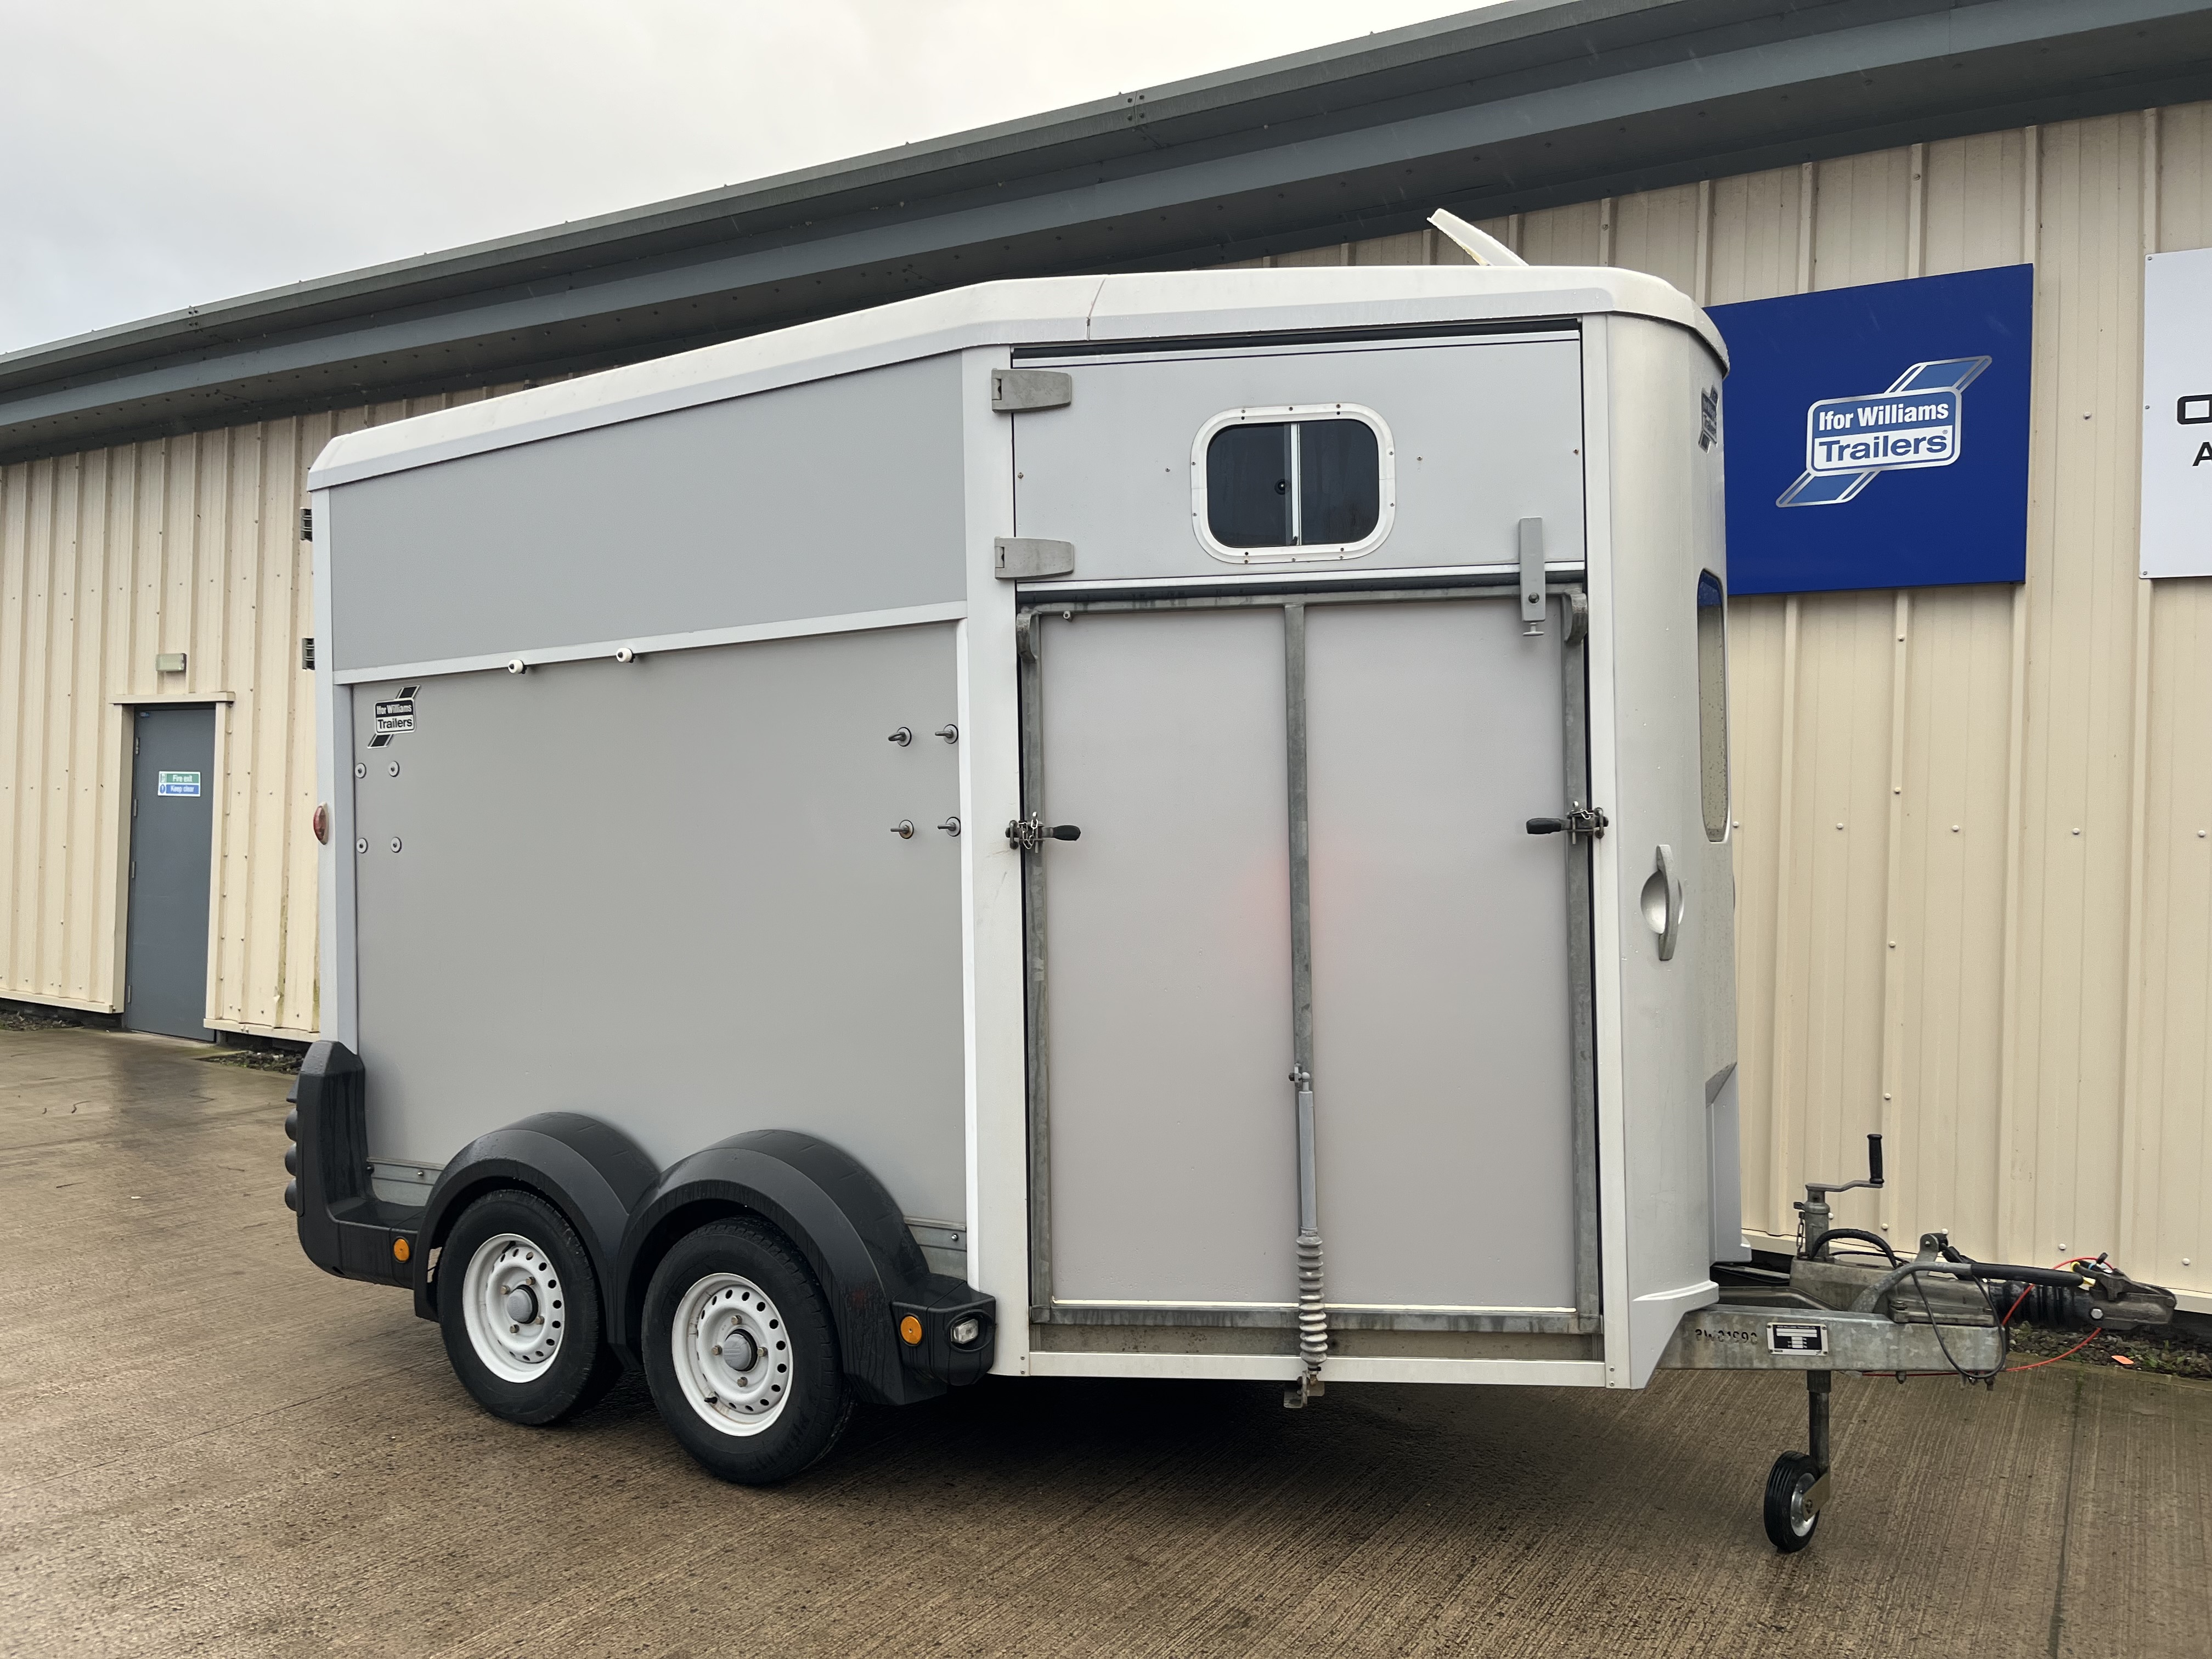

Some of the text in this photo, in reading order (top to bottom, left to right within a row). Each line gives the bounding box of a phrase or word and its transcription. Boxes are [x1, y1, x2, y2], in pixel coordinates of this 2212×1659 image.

[1819, 403, 1949, 431] Ifor Williams
[1818, 435, 1948, 462] Trailers
[376, 704, 412, 715] Ifor Williams
[377, 718, 413, 729] Trailers
[172, 774, 183, 782] Fire
[170, 785, 183, 793] Keep
